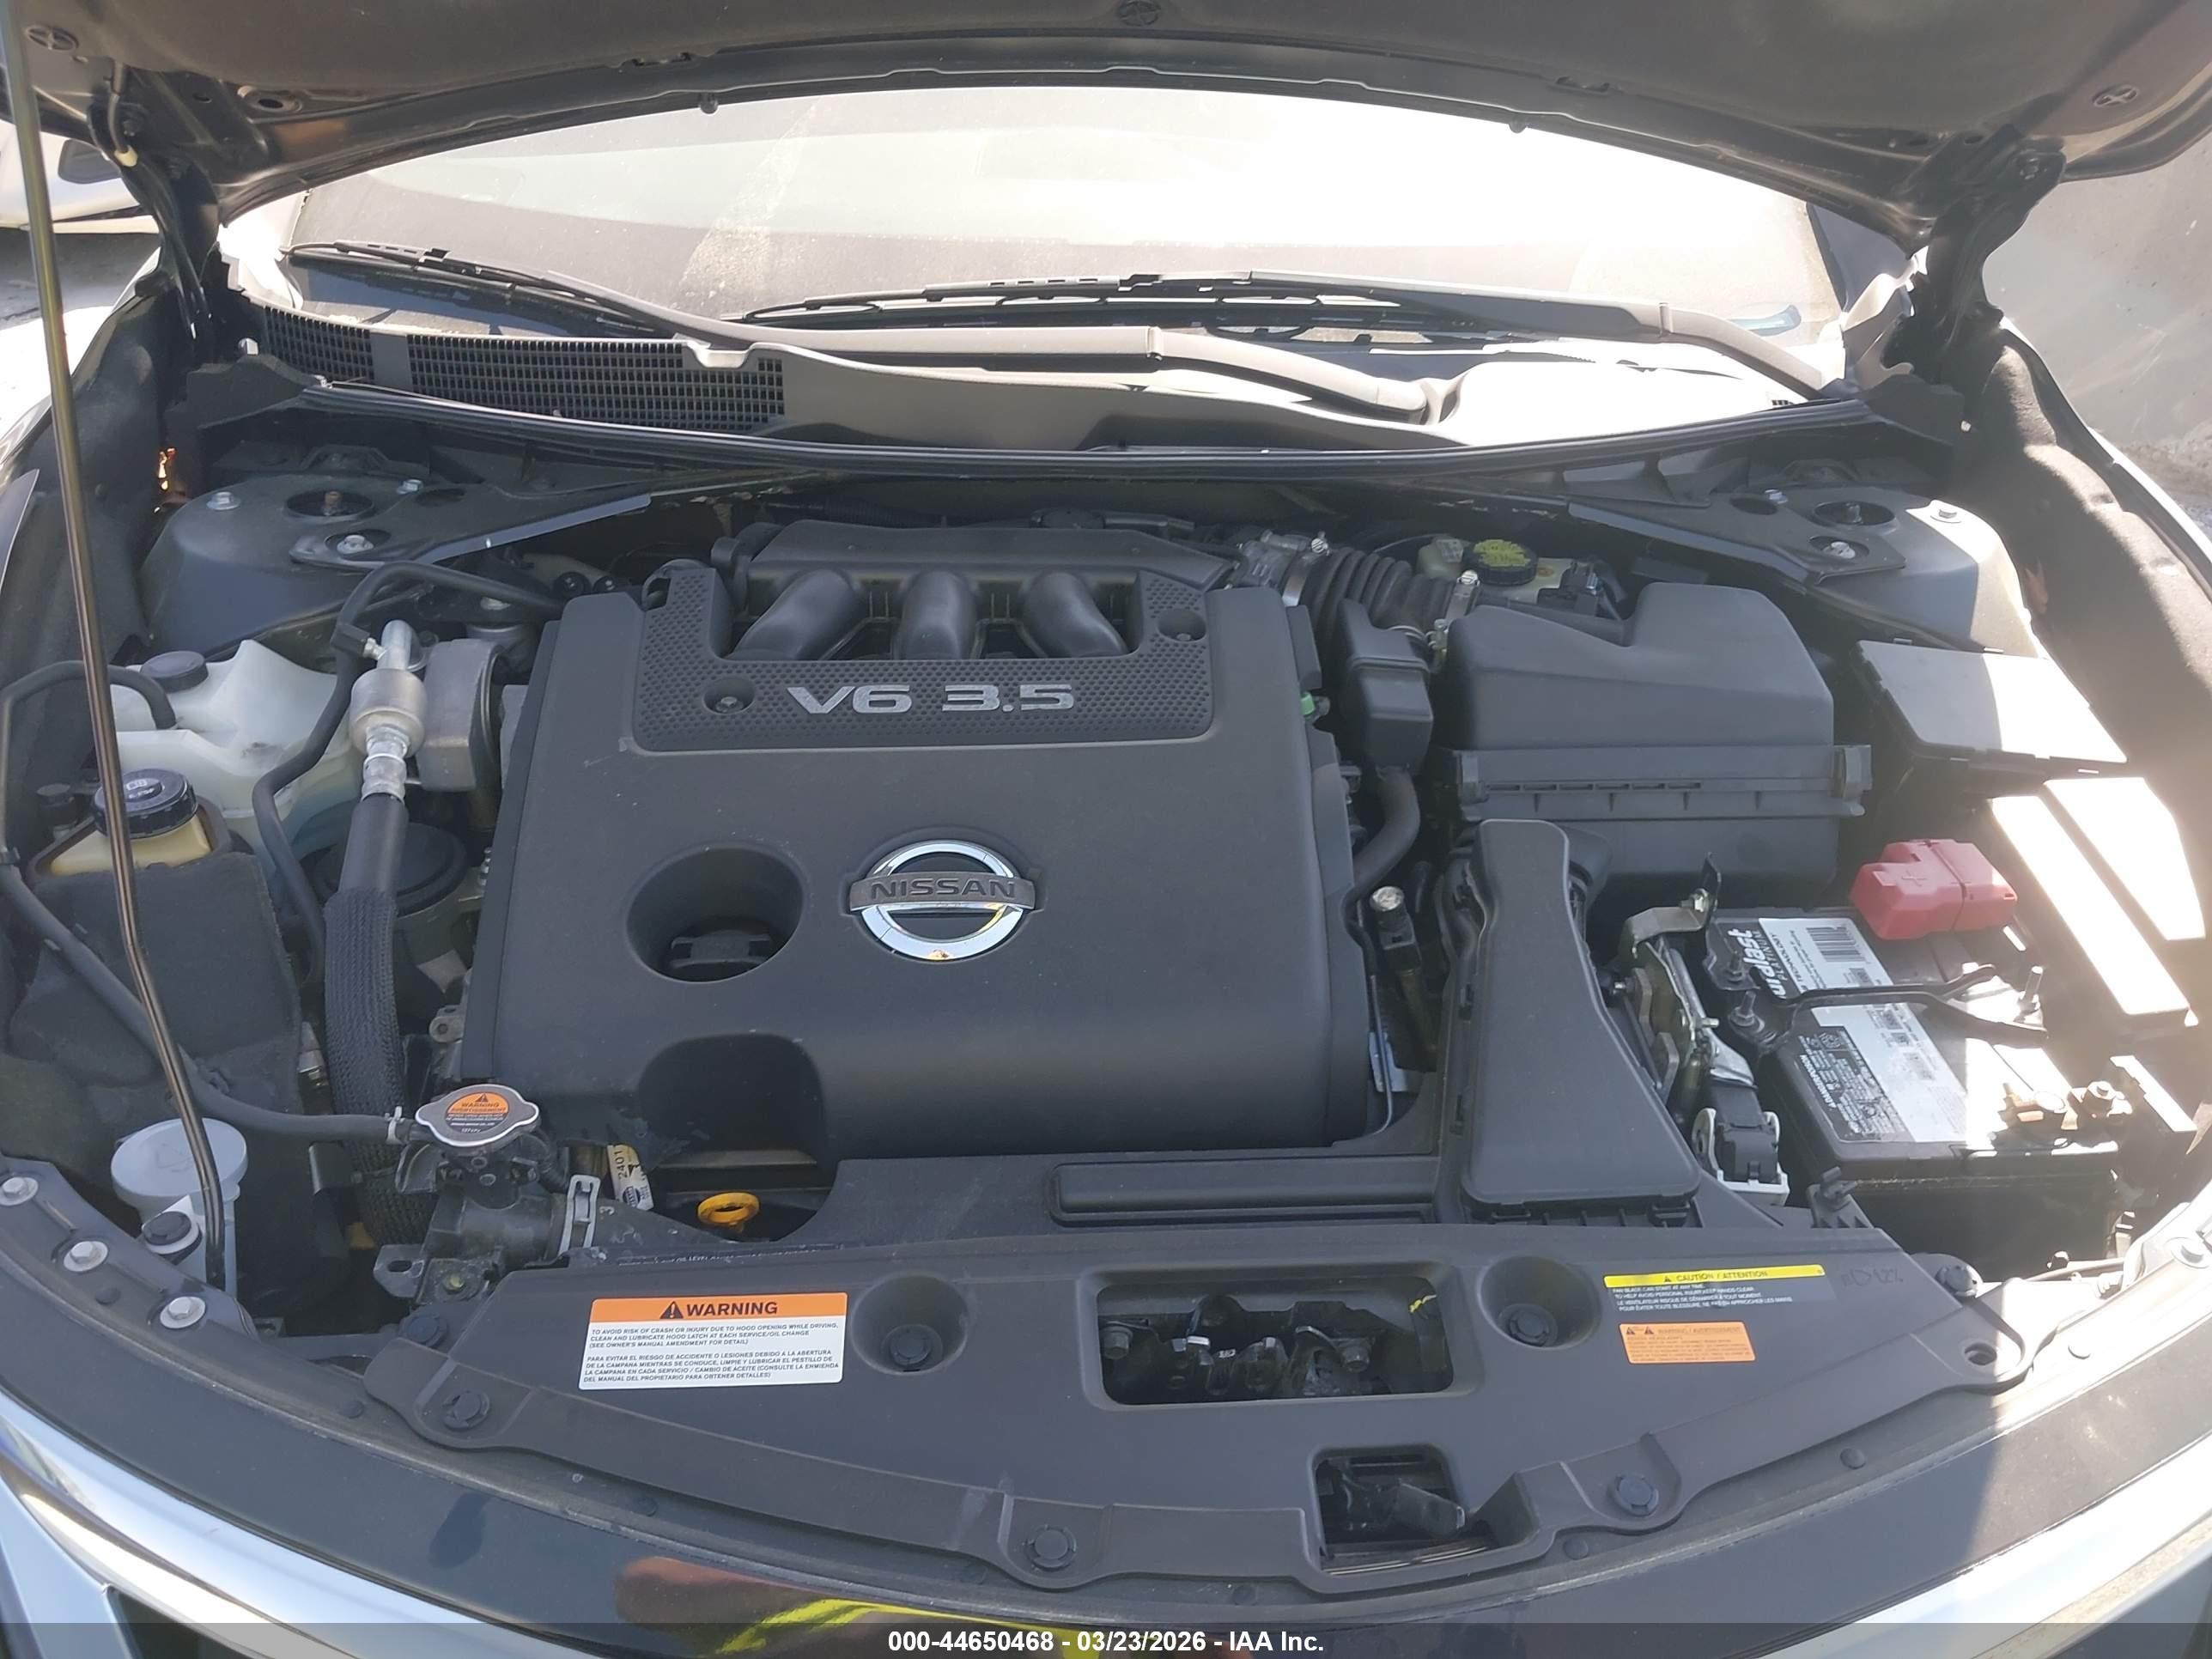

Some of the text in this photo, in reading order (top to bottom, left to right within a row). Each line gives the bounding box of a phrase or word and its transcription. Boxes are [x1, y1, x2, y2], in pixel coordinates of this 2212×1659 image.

[787, 684, 1074, 714] V6 3.5
[871, 878, 1015, 899] NISSAN
[1728, 928, 1787, 1000] uralast
[613, 1151, 629, 1180] 2401
[1676, 1273, 1714, 1282] CAUTION
[686, 1302, 778, 1316] WARNING
